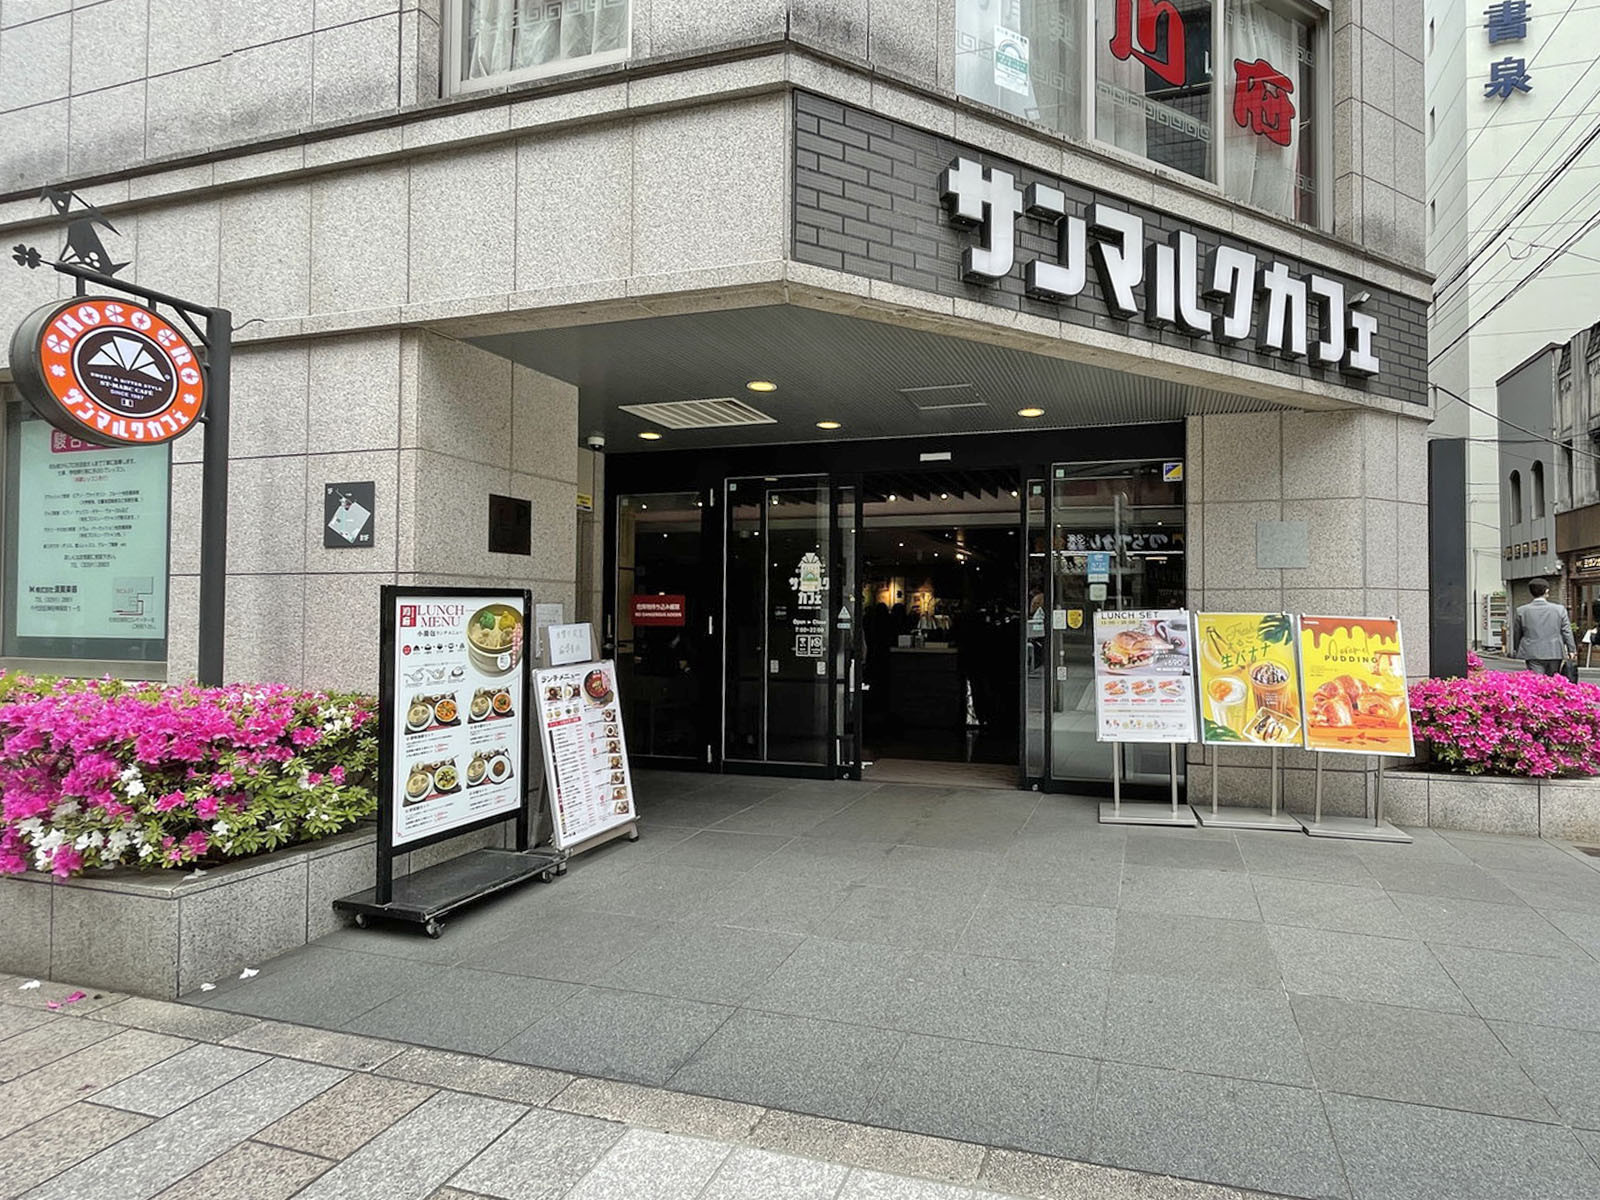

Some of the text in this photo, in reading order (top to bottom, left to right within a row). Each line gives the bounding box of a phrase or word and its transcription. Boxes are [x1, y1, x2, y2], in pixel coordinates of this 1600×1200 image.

[1483, 0, 1533, 98] 書泉
[940, 156, 1381, 378] サンマルクカフェ
[45, 304, 200, 385] CHOCO CRO
[62, 387, 190, 440] サンマルクカフェ
[417, 604, 465, 616] LUNCH
[797, 591, 822, 605] カフェ
[420, 616, 461, 628] MENU
[1101, 611, 1160, 620] LUNCH SET
